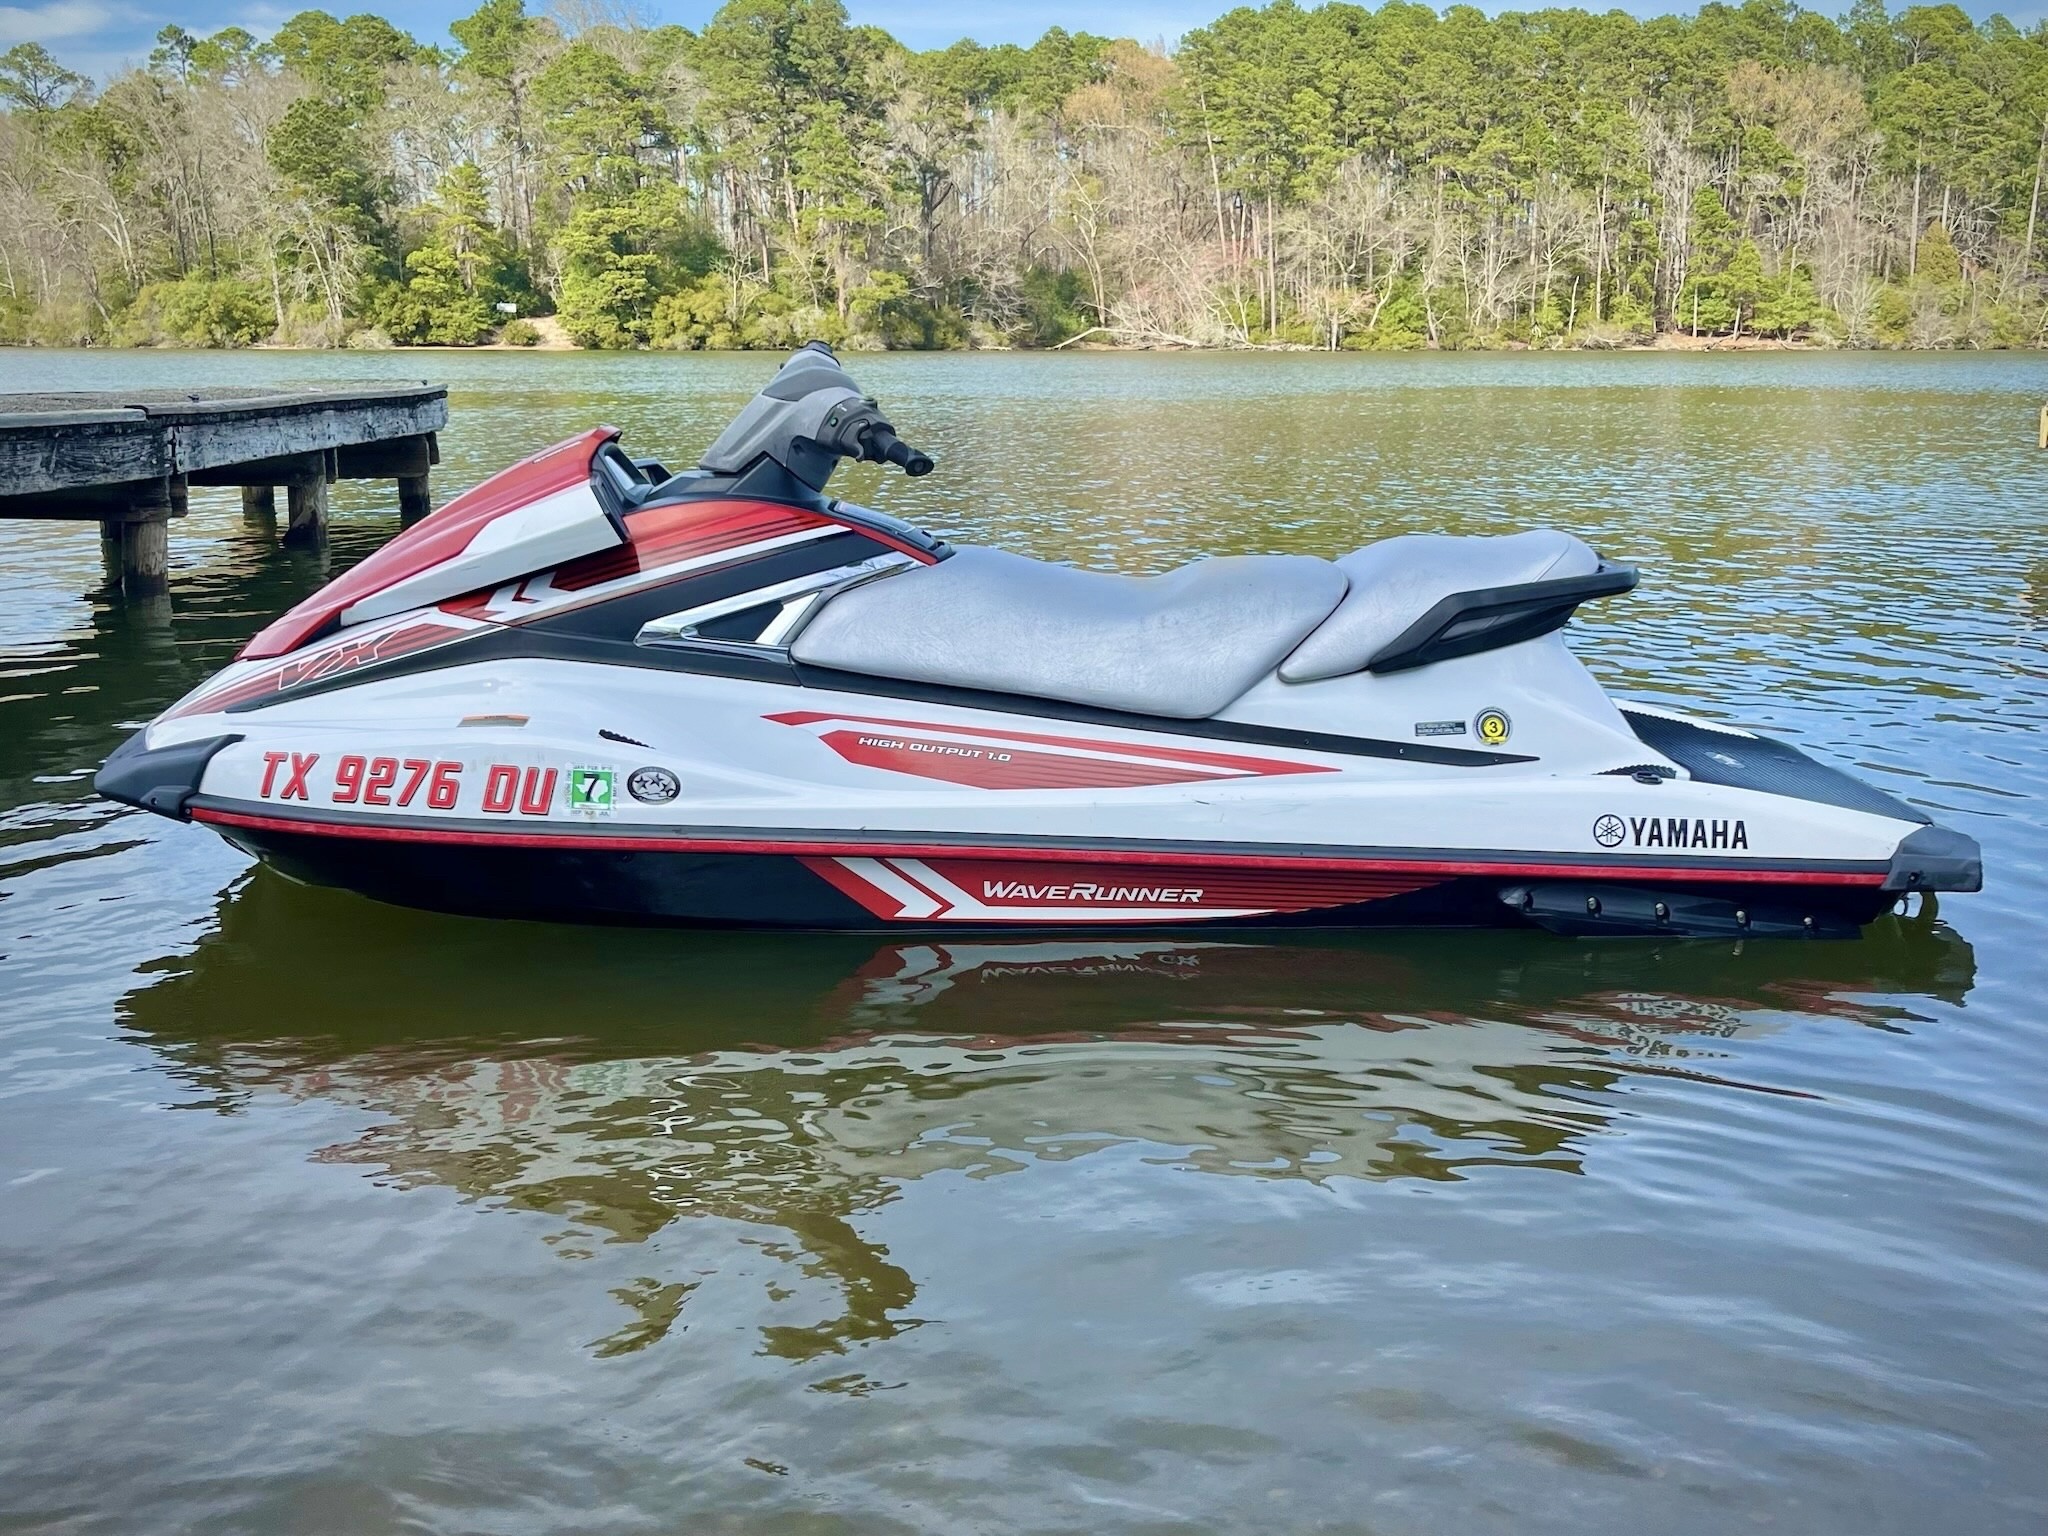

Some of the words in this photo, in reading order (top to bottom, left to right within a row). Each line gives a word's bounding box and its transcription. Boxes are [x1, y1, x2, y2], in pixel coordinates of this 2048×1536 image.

[278, 629, 400, 691] VX
[1489, 721, 1498, 733] 3
[858, 737, 905, 749] HIGH
[909, 743, 983, 758] OUTPUT
[987, 752, 1012, 762] 1.0
[260, 751, 319, 800] TX
[332, 755, 464, 809] 9276
[481, 764, 558, 815] DU
[583, 773, 600, 802] 7
[1629, 817, 1749, 850] YAMAHA
